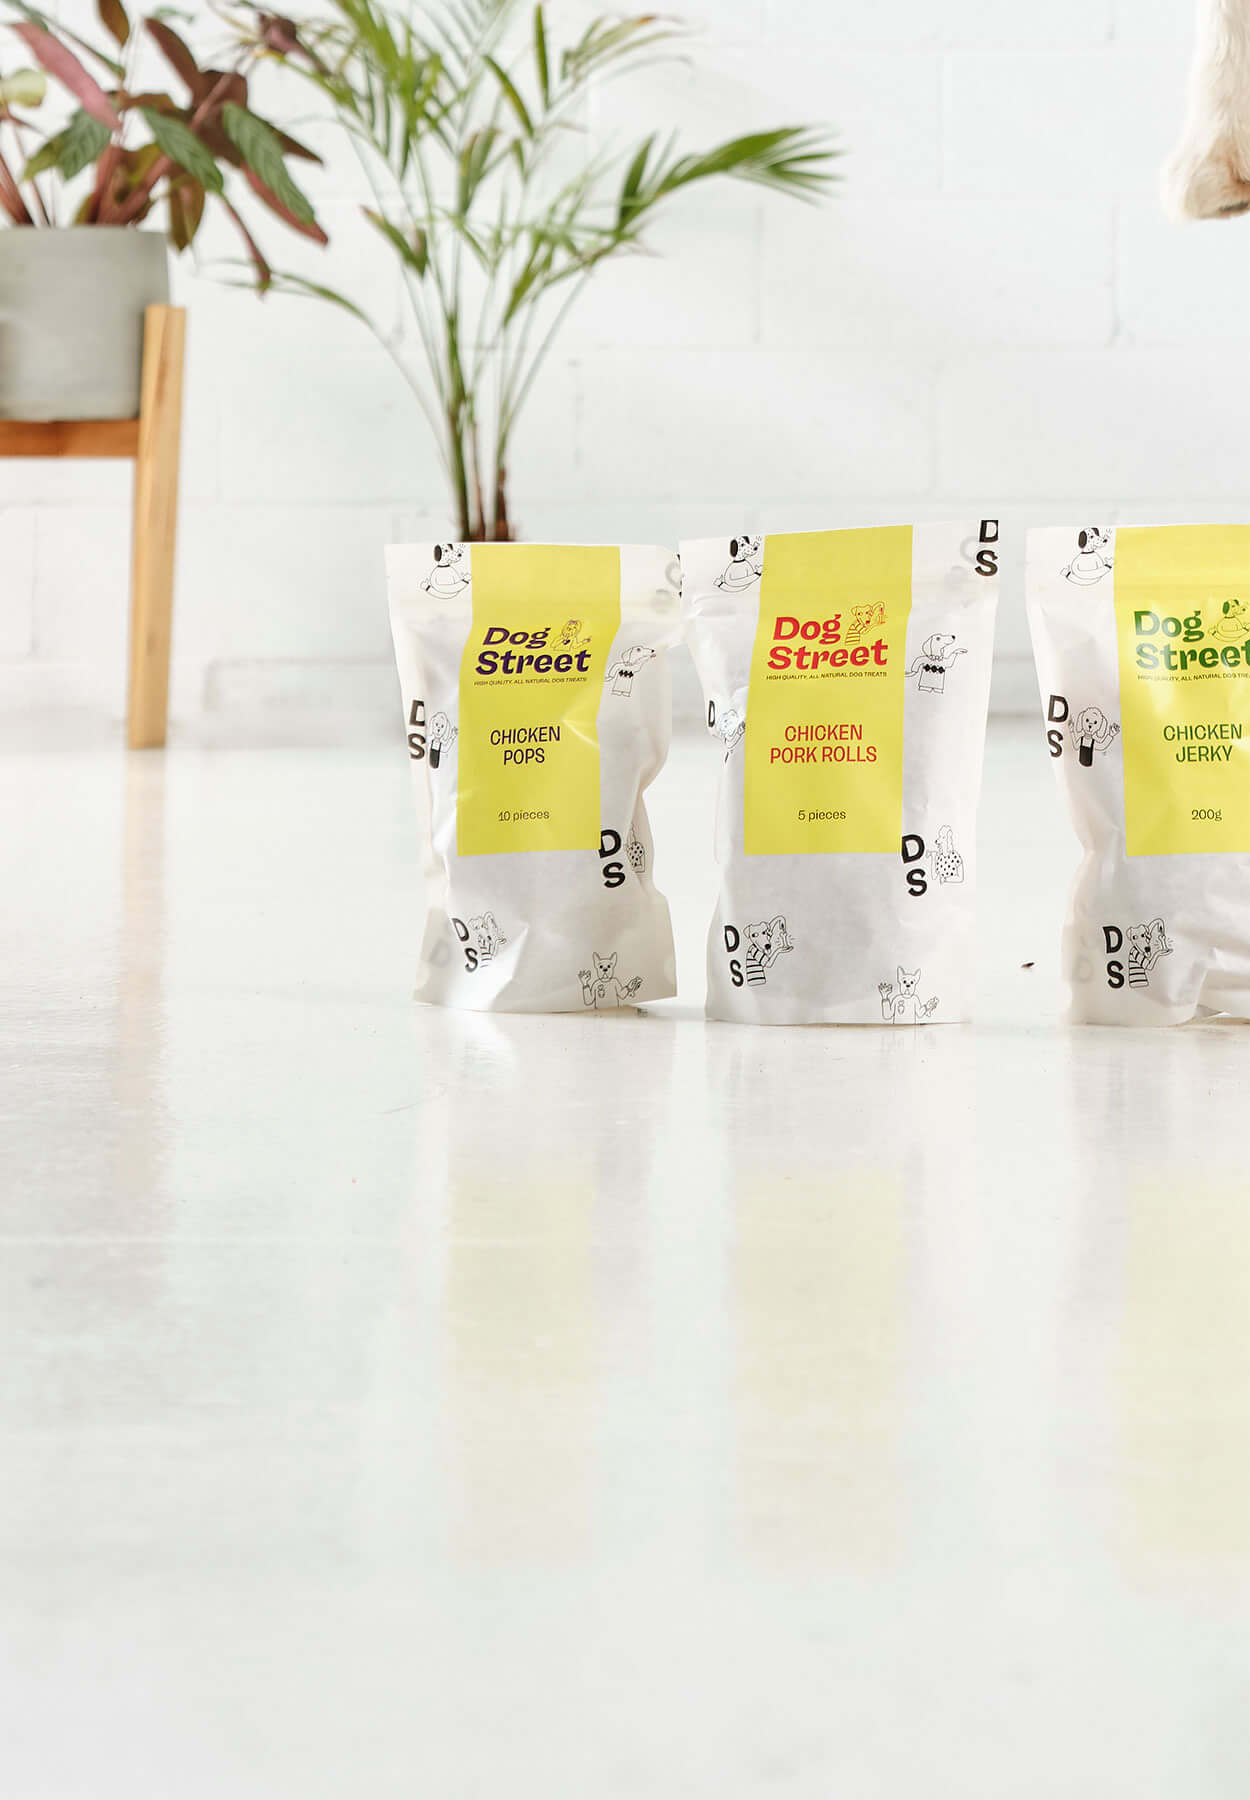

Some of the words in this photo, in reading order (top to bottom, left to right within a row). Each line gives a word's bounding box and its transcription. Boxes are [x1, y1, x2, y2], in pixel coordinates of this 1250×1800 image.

[773, 613, 842, 645] Dog
[1133, 610, 1205, 642] Dog
[482, 626, 552, 649] Dog
[475, 649, 592, 675] Street
[767, 638, 889, 670] Street
[820, 671, 849, 679] NATURAL
[1193, 673, 1220, 681] NATURAL
[490, 725, 561, 746] CHICKEN
[784, 723, 863, 742] CHICKEN
[1163, 723, 1243, 741] CHICKEN
[503, 747, 546, 766] POPS
[770, 746, 818, 764] PORK
[821, 745, 878, 763] ROLLS
[1175, 744, 1233, 763] JERKY
[498, 810, 511, 822] 10
[513, 809, 550, 823] pieces
[798, 809, 806, 821] 5
[808, 808, 847, 823] pieces
[1191, 808, 1223, 822] 200g
